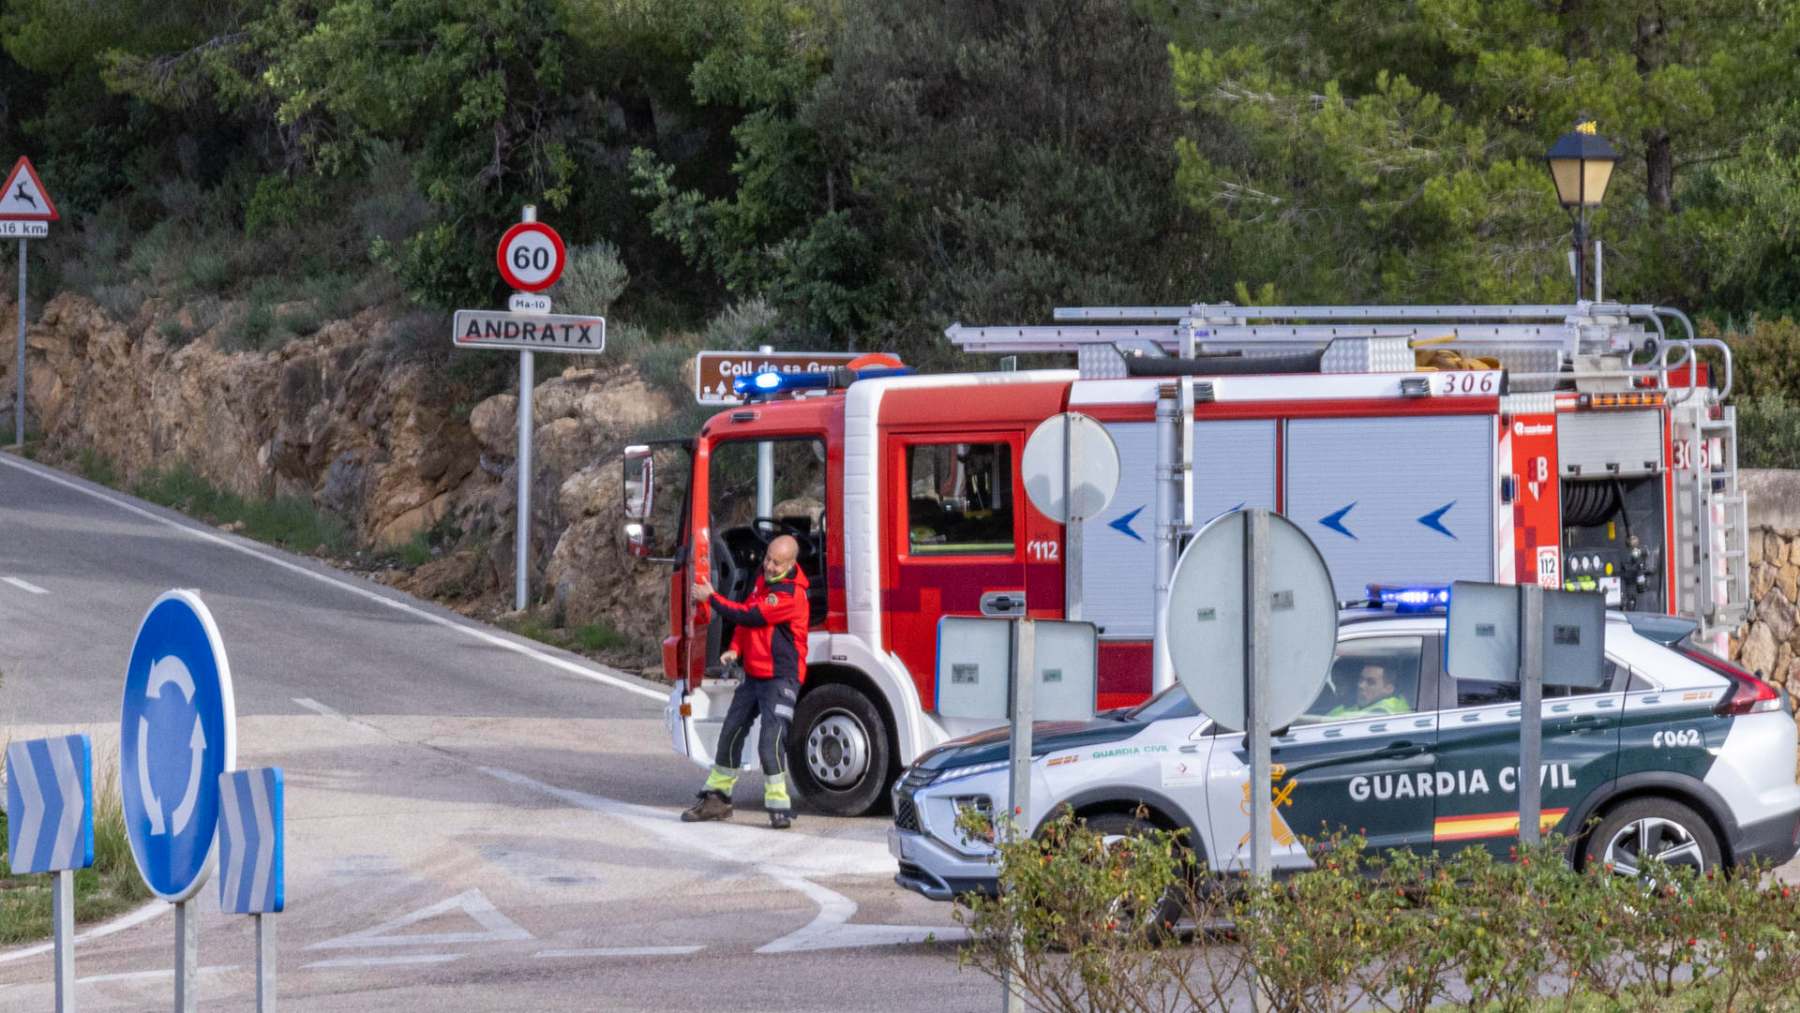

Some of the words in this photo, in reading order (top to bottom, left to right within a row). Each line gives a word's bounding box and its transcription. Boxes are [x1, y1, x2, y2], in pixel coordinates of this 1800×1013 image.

[23, 222, 44, 234] km
[514, 246, 549, 270] 60
[515, 299, 545, 309] Ma-10
[466, 319, 592, 343] ANDRATX
[719, 360, 753, 377] Coll
[1443, 373, 1493, 393] 306
[1034, 541, 1058, 560] 112
[1541, 558, 1555, 574] 112
[1093, 747, 1140, 759] GUARDIA
[1349, 769, 1489, 801] GUARDIA
[1498, 763, 1577, 792] CIL
